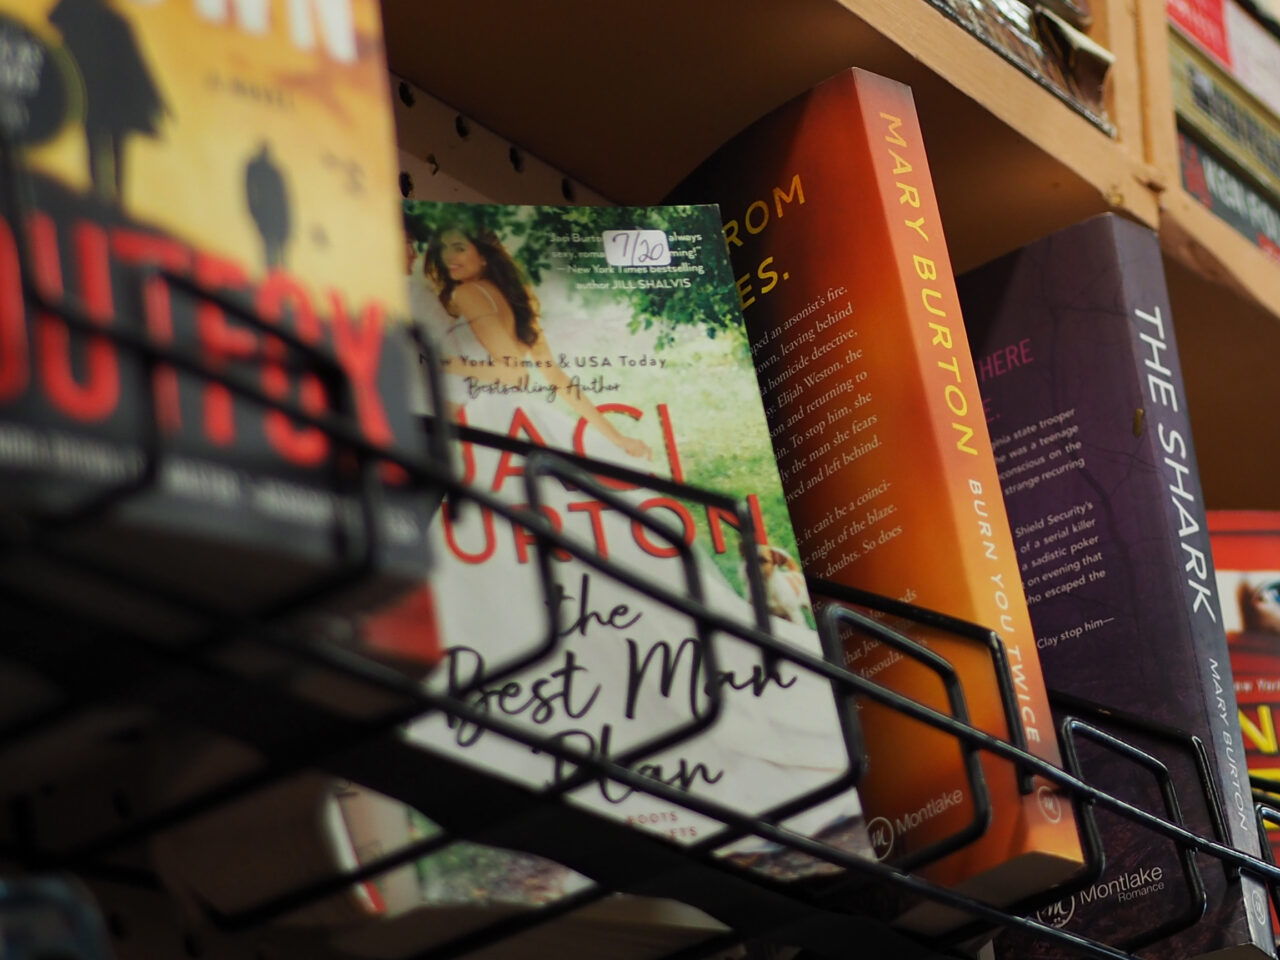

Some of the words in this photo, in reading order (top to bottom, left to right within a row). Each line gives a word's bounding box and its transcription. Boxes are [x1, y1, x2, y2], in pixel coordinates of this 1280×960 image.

[726, 174, 807, 251] ROM
[611, 231, 665, 266] 7/20
[668, 232, 703, 244] always
[612, 279, 637, 290] JILL
[638, 277, 692, 290] SHALVIS
[650, 262, 705, 275] bestselling
[878, 111, 929, 244] MARY
[911, 253, 980, 457] BURTON
[771, 327, 783, 341] an
[784, 295, 827, 331] arsonist's
[828, 285, 849, 303] fire.
[781, 329, 817, 357] leaving
[816, 300, 854, 333] behind
[459, 354, 496, 368] York
[503, 355, 553, 369] Times
[559, 354, 572, 369] &
[575, 357, 612, 368] USA
[618, 355, 668, 370] Today
[767, 356, 811, 391] homicide
[811, 328, 859, 361] detective,
[776, 383, 805, 409] Elijah
[845, 347, 864, 364] the
[464, 374, 559, 403] Bestselling
[566, 374, 621, 401] Author
[787, 405, 805, 428] and
[806, 378, 855, 414] returning
[855, 370, 869, 384] to
[789, 433, 804, 450] To
[805, 419, 827, 440] stop
[827, 404, 853, 426] him,
[853, 391, 873, 409] she
[1009, 444, 1028, 459] was
[1030, 441, 1037, 450] a
[1039, 424, 1080, 447] teenage
[1013, 424, 1037, 441] state
[1039, 407, 1076, 430] trooper
[455, 402, 685, 493] JACI
[791, 457, 808, 474] the
[808, 442, 832, 463] man
[832, 429, 851, 447] she
[852, 413, 879, 436] fears
[807, 467, 825, 490] and
[825, 457, 841, 478] left
[843, 433, 883, 466] behind.
[1000, 455, 1046, 480] conscious
[1048, 448, 1062, 461] on
[1065, 440, 1083, 454] the
[1133, 304, 1179, 414] THE
[1157, 422, 1218, 625] SHARK
[1004, 475, 1041, 496] strange
[1041, 457, 1086, 480] recurring
[813, 512, 835, 534] can't
[835, 505, 848, 520] be
[849, 502, 856, 512] a
[856, 479, 892, 507] coinci-
[1014, 517, 1046, 539] Shield
[1047, 500, 1094, 526] Security's
[811, 539, 837, 560] night
[837, 525, 849, 544] of
[849, 520, 866, 537] the
[867, 503, 898, 526] blaze.
[825, 550, 861, 578] doubts.
[862, 539, 877, 554] So
[878, 524, 903, 545] does
[1020, 542, 1032, 555] of
[1034, 540, 1041, 549] a
[1044, 527, 1070, 545] serial
[1072, 518, 1097, 533] killer
[1031, 547, 1067, 569] sadistic
[1070, 534, 1100, 555] poker
[1027, 577, 1041, 587] on
[1042, 561, 1082, 582] evening
[1082, 551, 1104, 567] that
[1045, 575, 1087, 600] escaped
[1088, 568, 1107, 583] the
[968, 477, 999, 562] BURN
[989, 572, 1016, 635] YOU
[1006, 644, 1041, 745] TWICE
[1036, 635, 1060, 650] Clay
[1060, 625, 1084, 641] stop
[1208, 657, 1230, 727] MARY
[1221, 729, 1249, 833] BURTON
[896, 789, 965, 838] Montlake
[1079, 864, 1164, 906] Montlake
[1117, 880, 1166, 904] Romance
